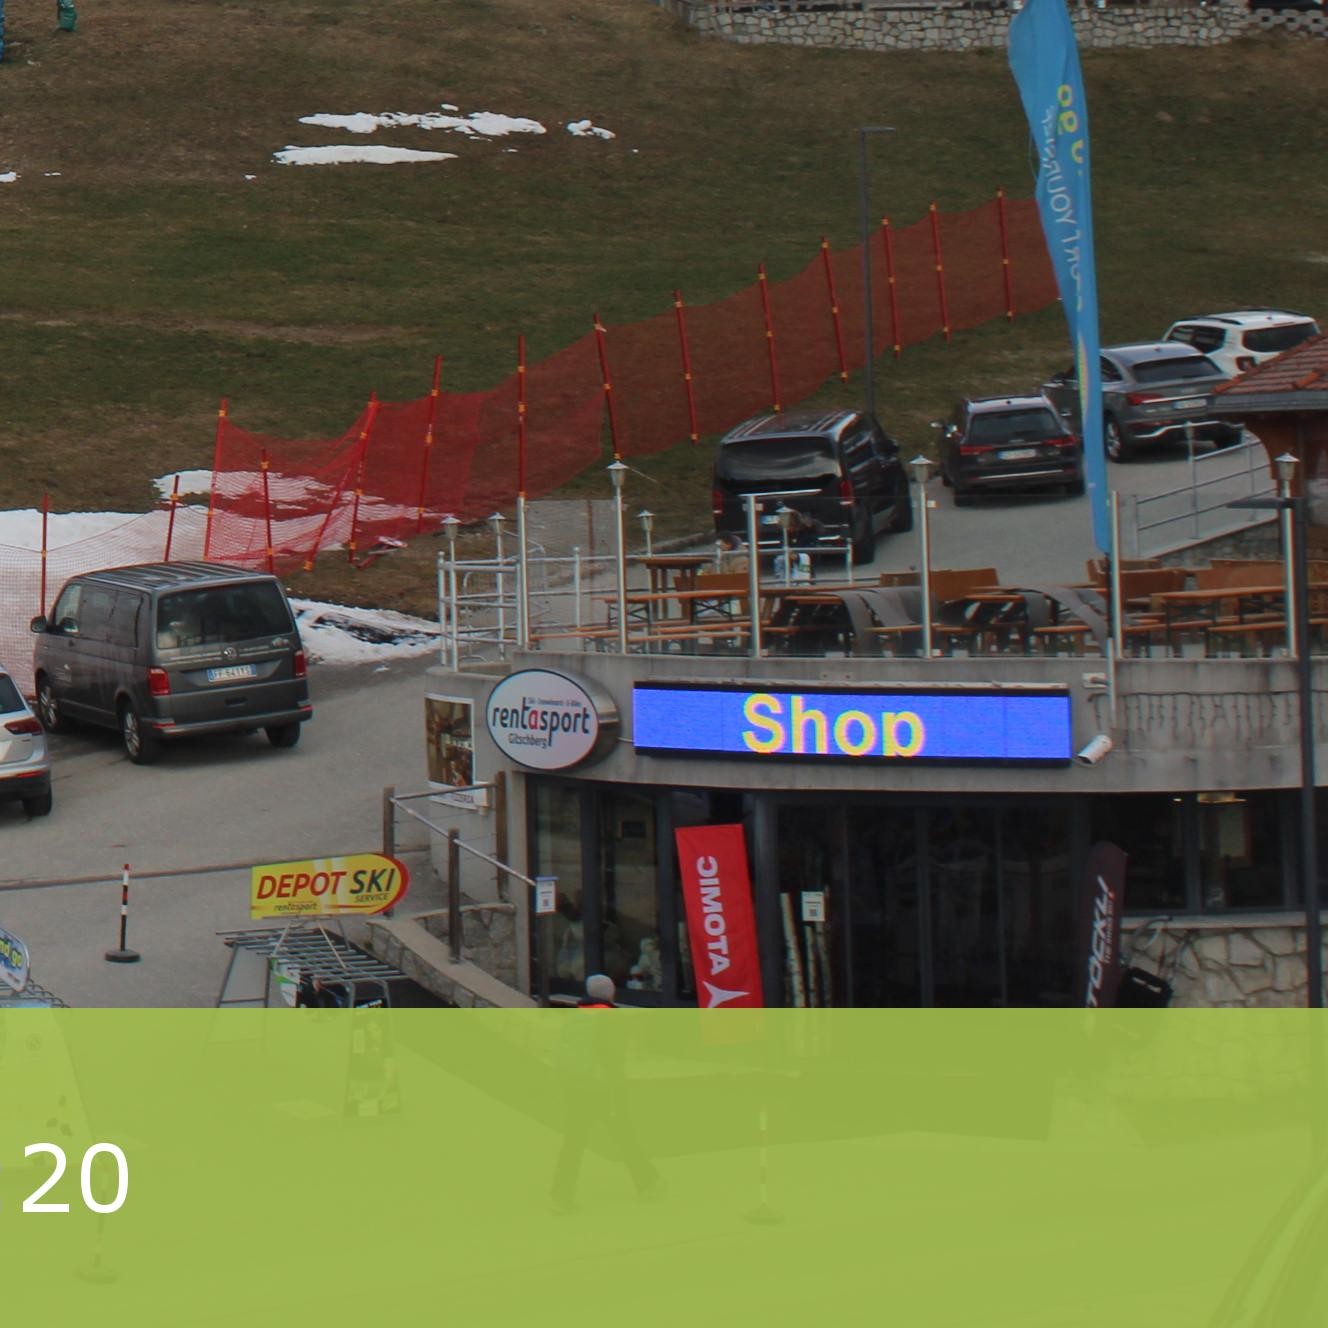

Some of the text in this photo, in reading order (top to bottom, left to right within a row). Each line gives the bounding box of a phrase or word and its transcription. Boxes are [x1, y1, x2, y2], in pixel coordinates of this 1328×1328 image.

[492, 697, 591, 747] rentasport
[507, 732, 549, 749] Gitschberg
[742, 692, 924, 757] Shop
[256, 868, 396, 900] DEPOT SKI
